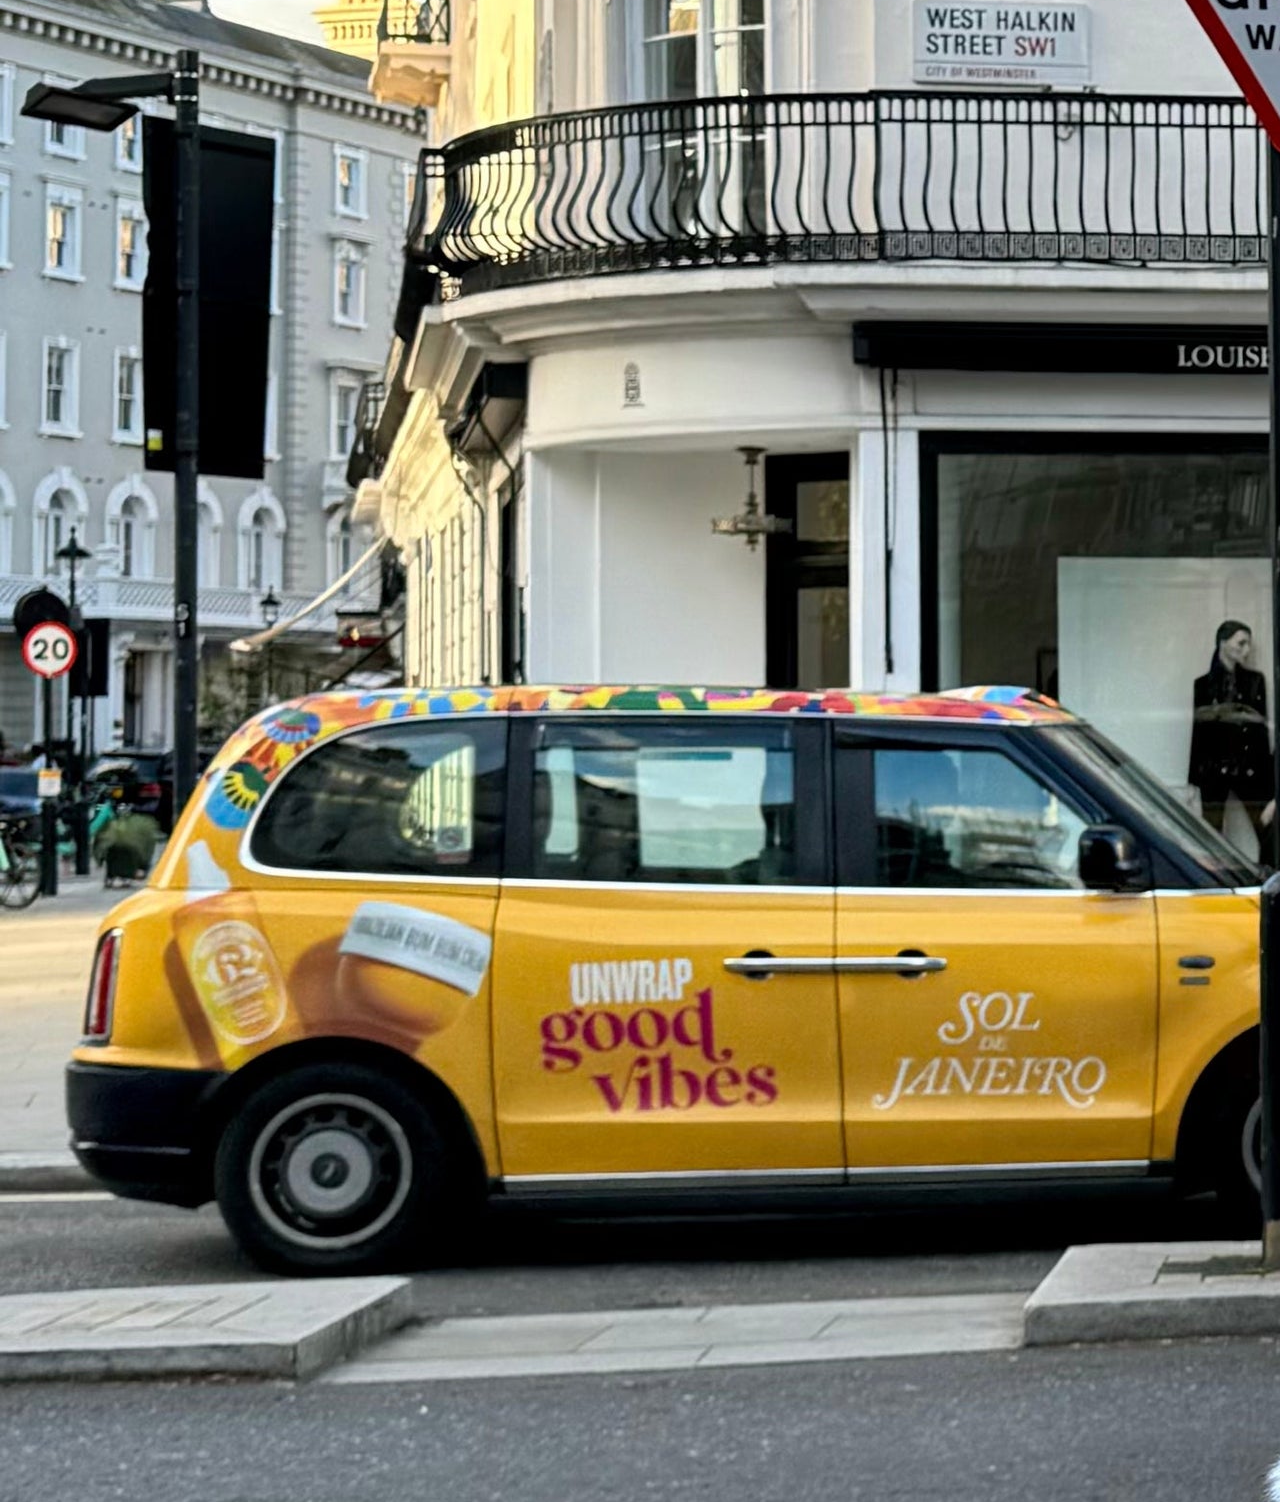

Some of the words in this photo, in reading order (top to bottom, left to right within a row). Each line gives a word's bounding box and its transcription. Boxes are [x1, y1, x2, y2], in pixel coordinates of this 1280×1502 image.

[925, 33, 1007, 57] STREET
[1013, 35, 1057, 58] SW1
[926, 7, 987, 30] WEST
[996, 10, 1076, 33] HALKIN
[32, 637, 71, 661] 20
[569, 956, 694, 1007] UNWRAP
[539, 986, 735, 1075] good
[936, 990, 1042, 1045] SOL
[591, 1050, 780, 1114] vibes
[871, 1055, 1108, 1111] JANEIRO
